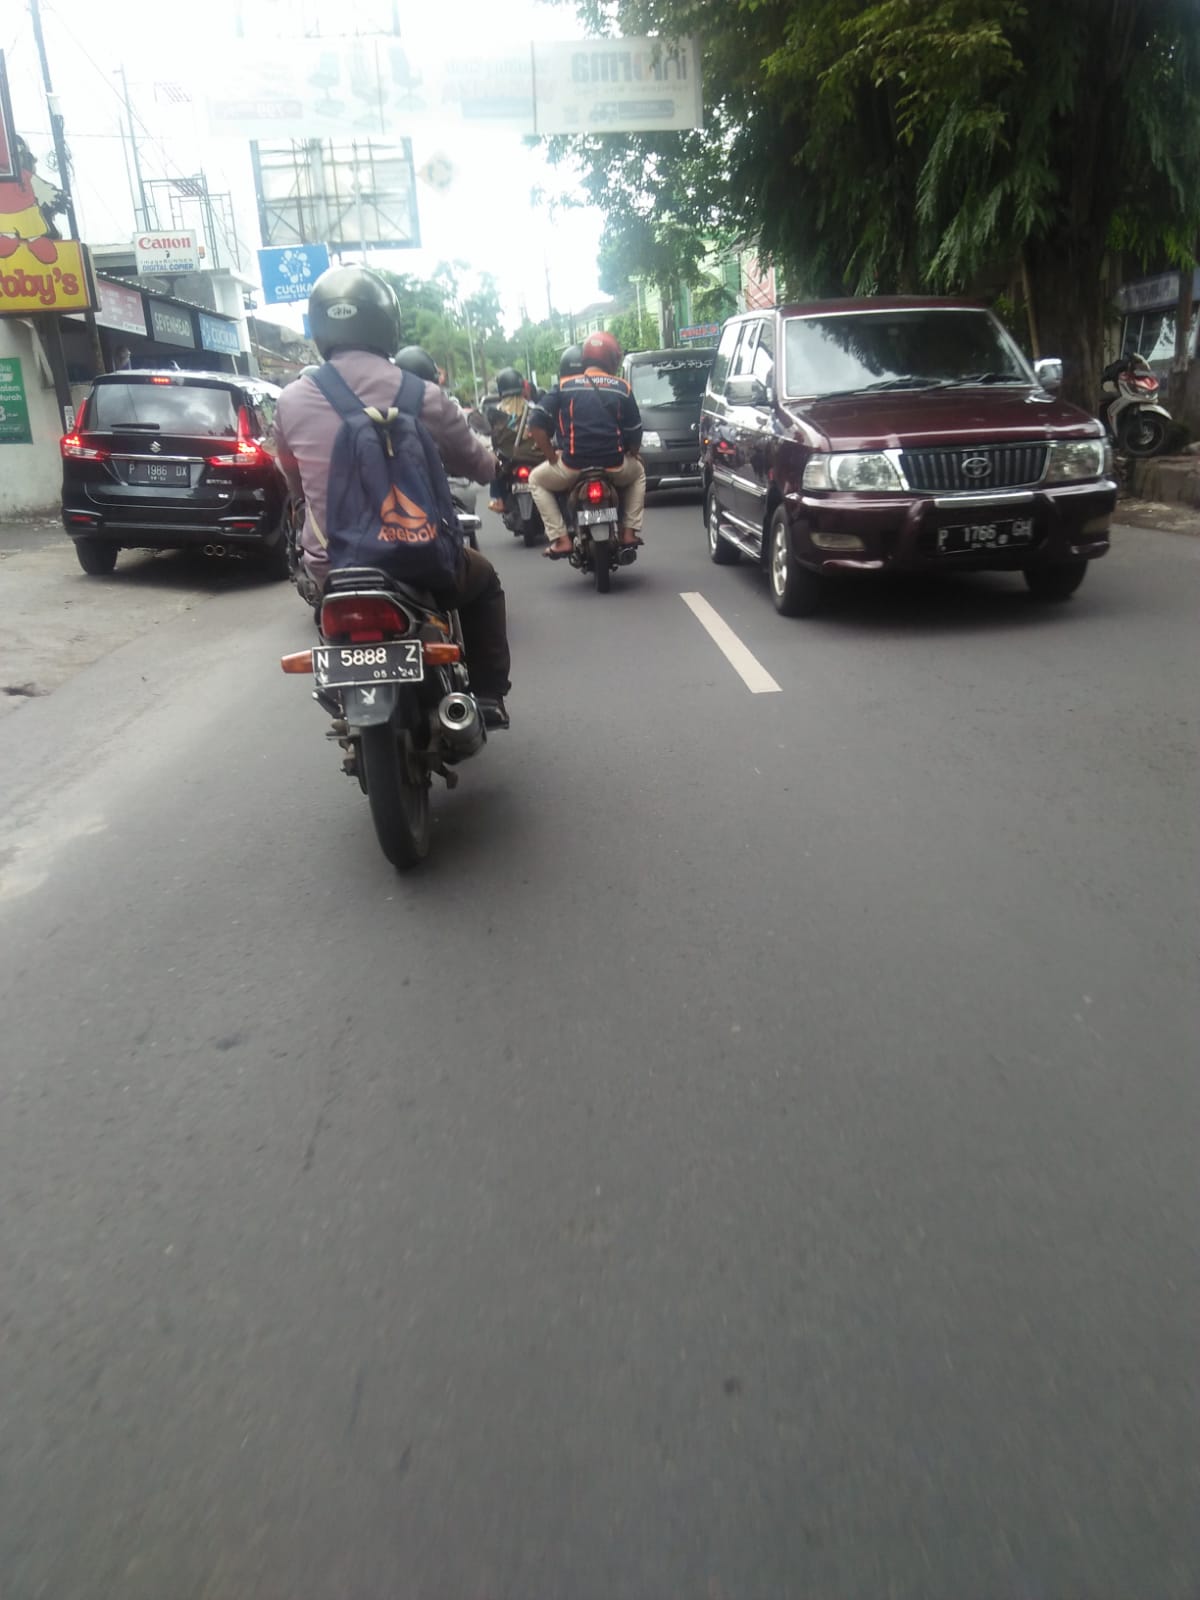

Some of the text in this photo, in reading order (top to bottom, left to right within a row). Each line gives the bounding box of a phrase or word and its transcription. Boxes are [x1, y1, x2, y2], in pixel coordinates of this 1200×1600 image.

[138, 237, 191, 249] Canon
[169, 263, 193, 271] COPIER
[129, 464, 188, 477] P 1986 DX
[938, 529, 949, 546] P
[317, 644, 419, 669] N 5888 Z
